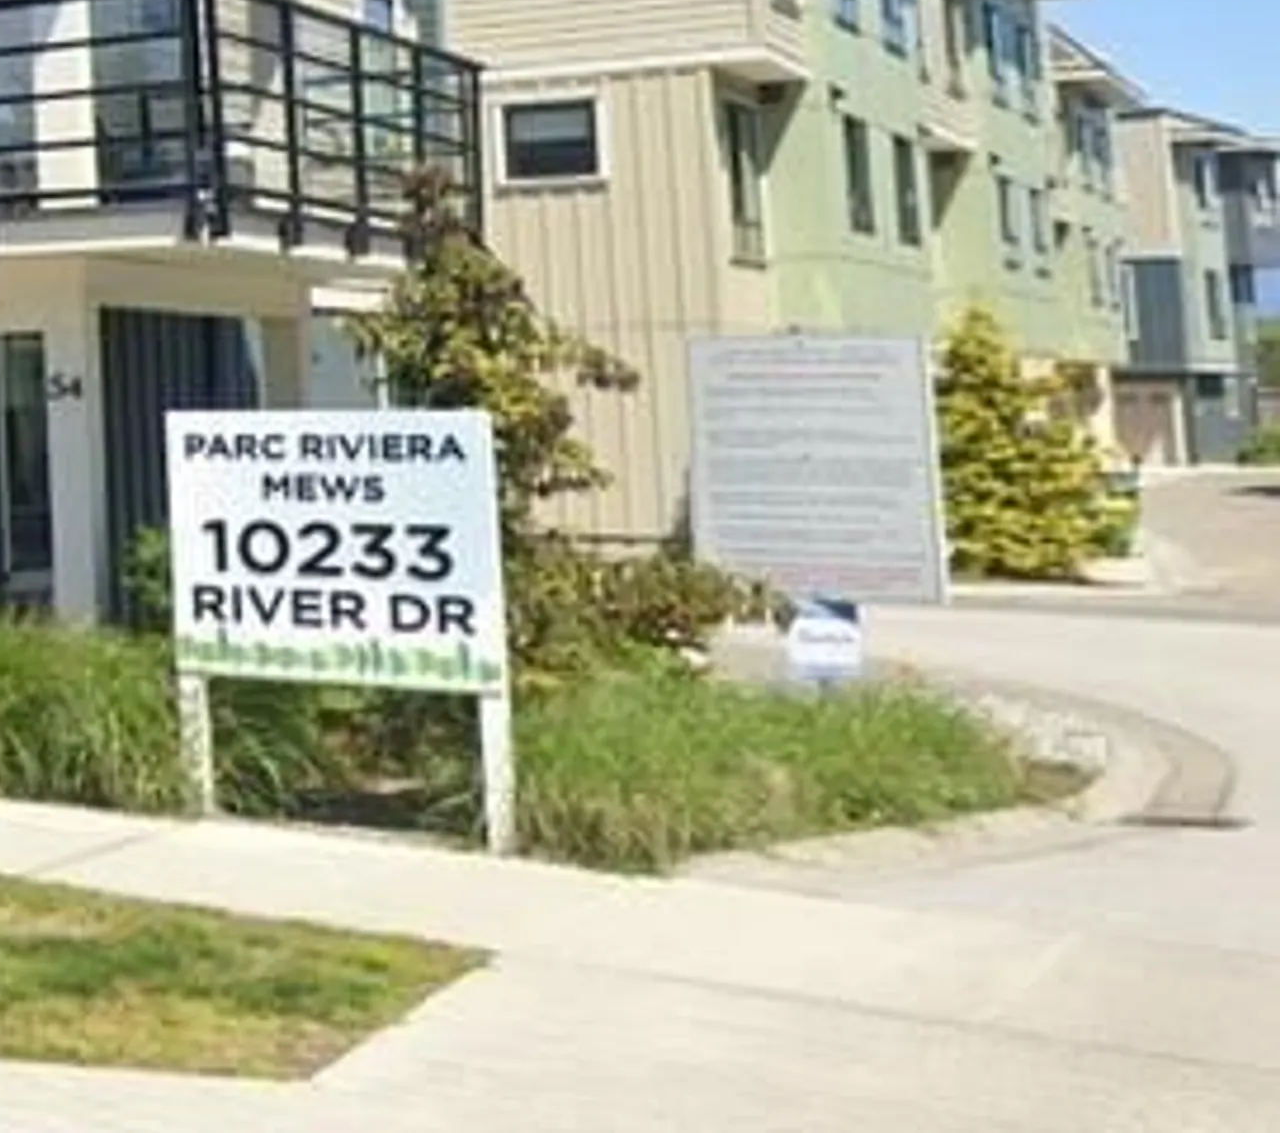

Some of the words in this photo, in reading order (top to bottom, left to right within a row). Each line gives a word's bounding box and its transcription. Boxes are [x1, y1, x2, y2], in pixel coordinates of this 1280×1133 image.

[46, 371, 83, 401] 54
[184, 434, 285, 460] PARC
[298, 434, 466, 462] RIVIERA
[262, 474, 386, 503] MEWS
[202, 519, 455, 582] 10233
[193, 584, 367, 631] RIVER
[390, 594, 477, 636] DR
